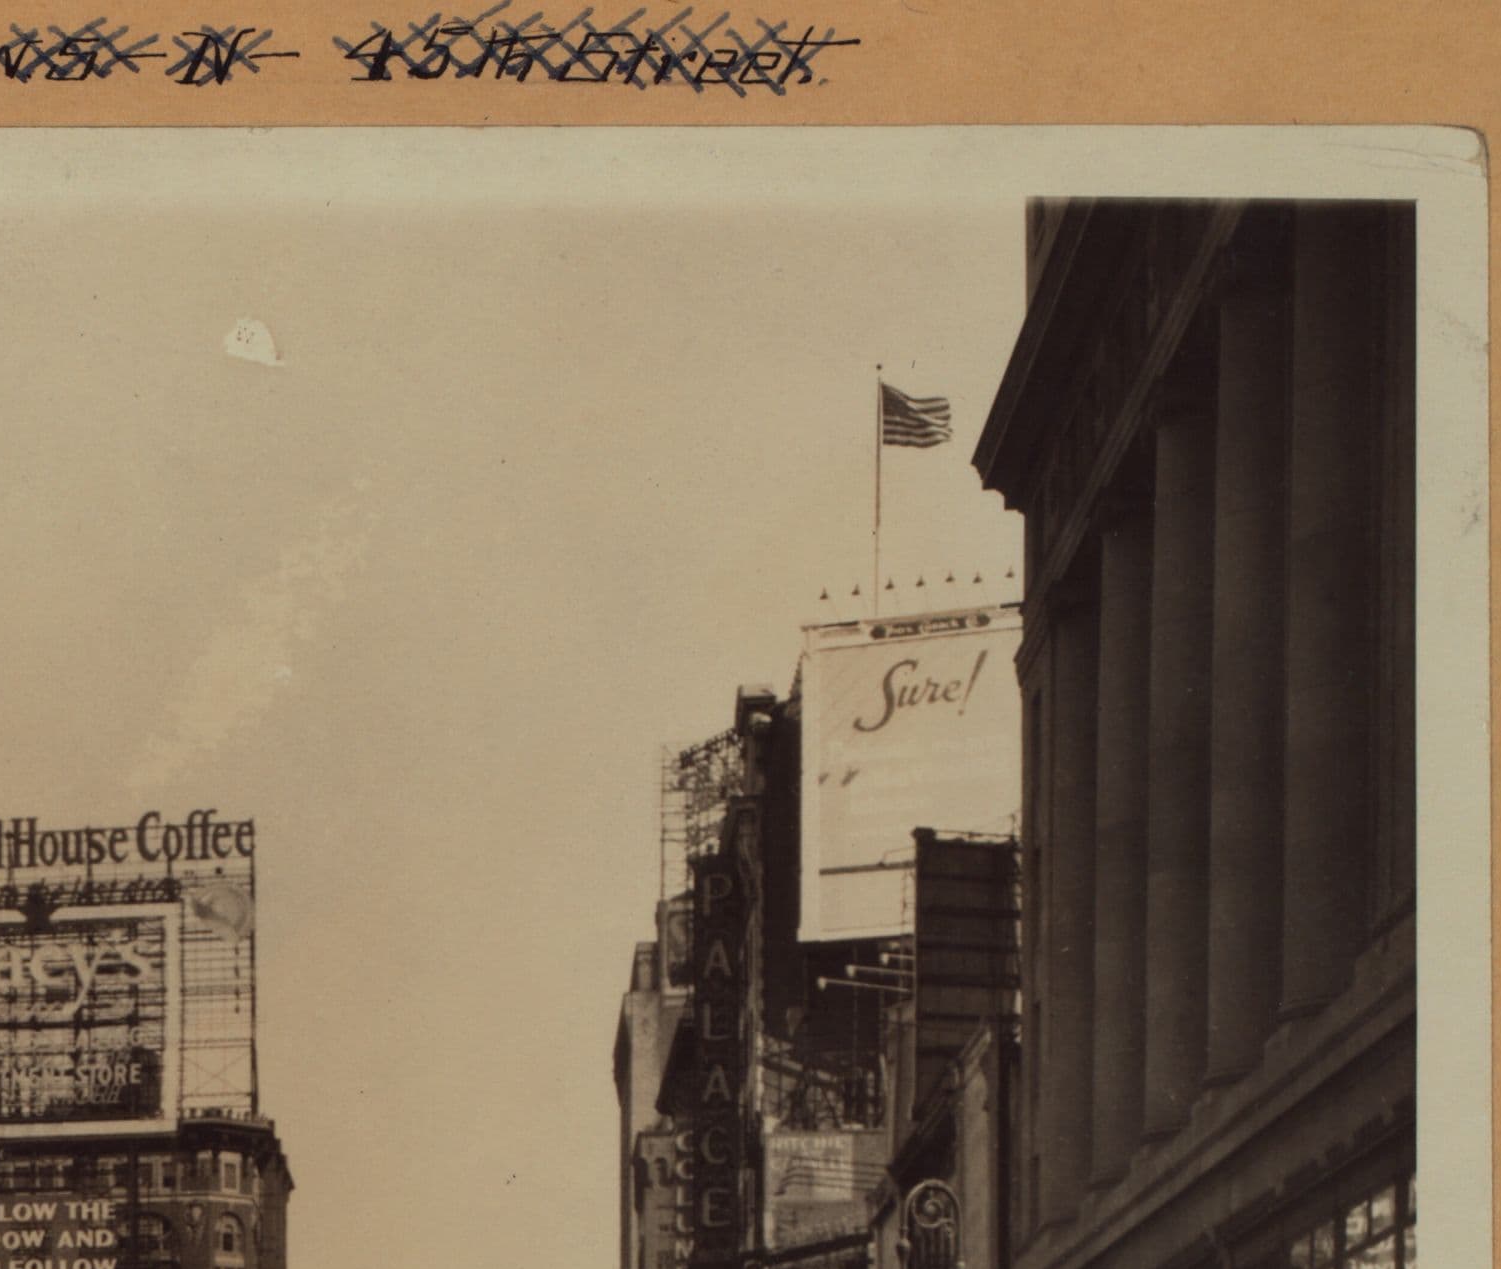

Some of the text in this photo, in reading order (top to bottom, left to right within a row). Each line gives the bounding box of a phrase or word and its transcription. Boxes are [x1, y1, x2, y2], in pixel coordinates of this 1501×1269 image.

[853, 649, 988, 733] Sure!
[11, 816, 129, 868] House
[136, 809, 255, 863] Coffee
[701, 872, 734, 1228] PALACE
[76, 1062, 143, 1085] STORE
[66, 1201, 117, 1222] THE
[58, 1228, 115, 1249] AND
